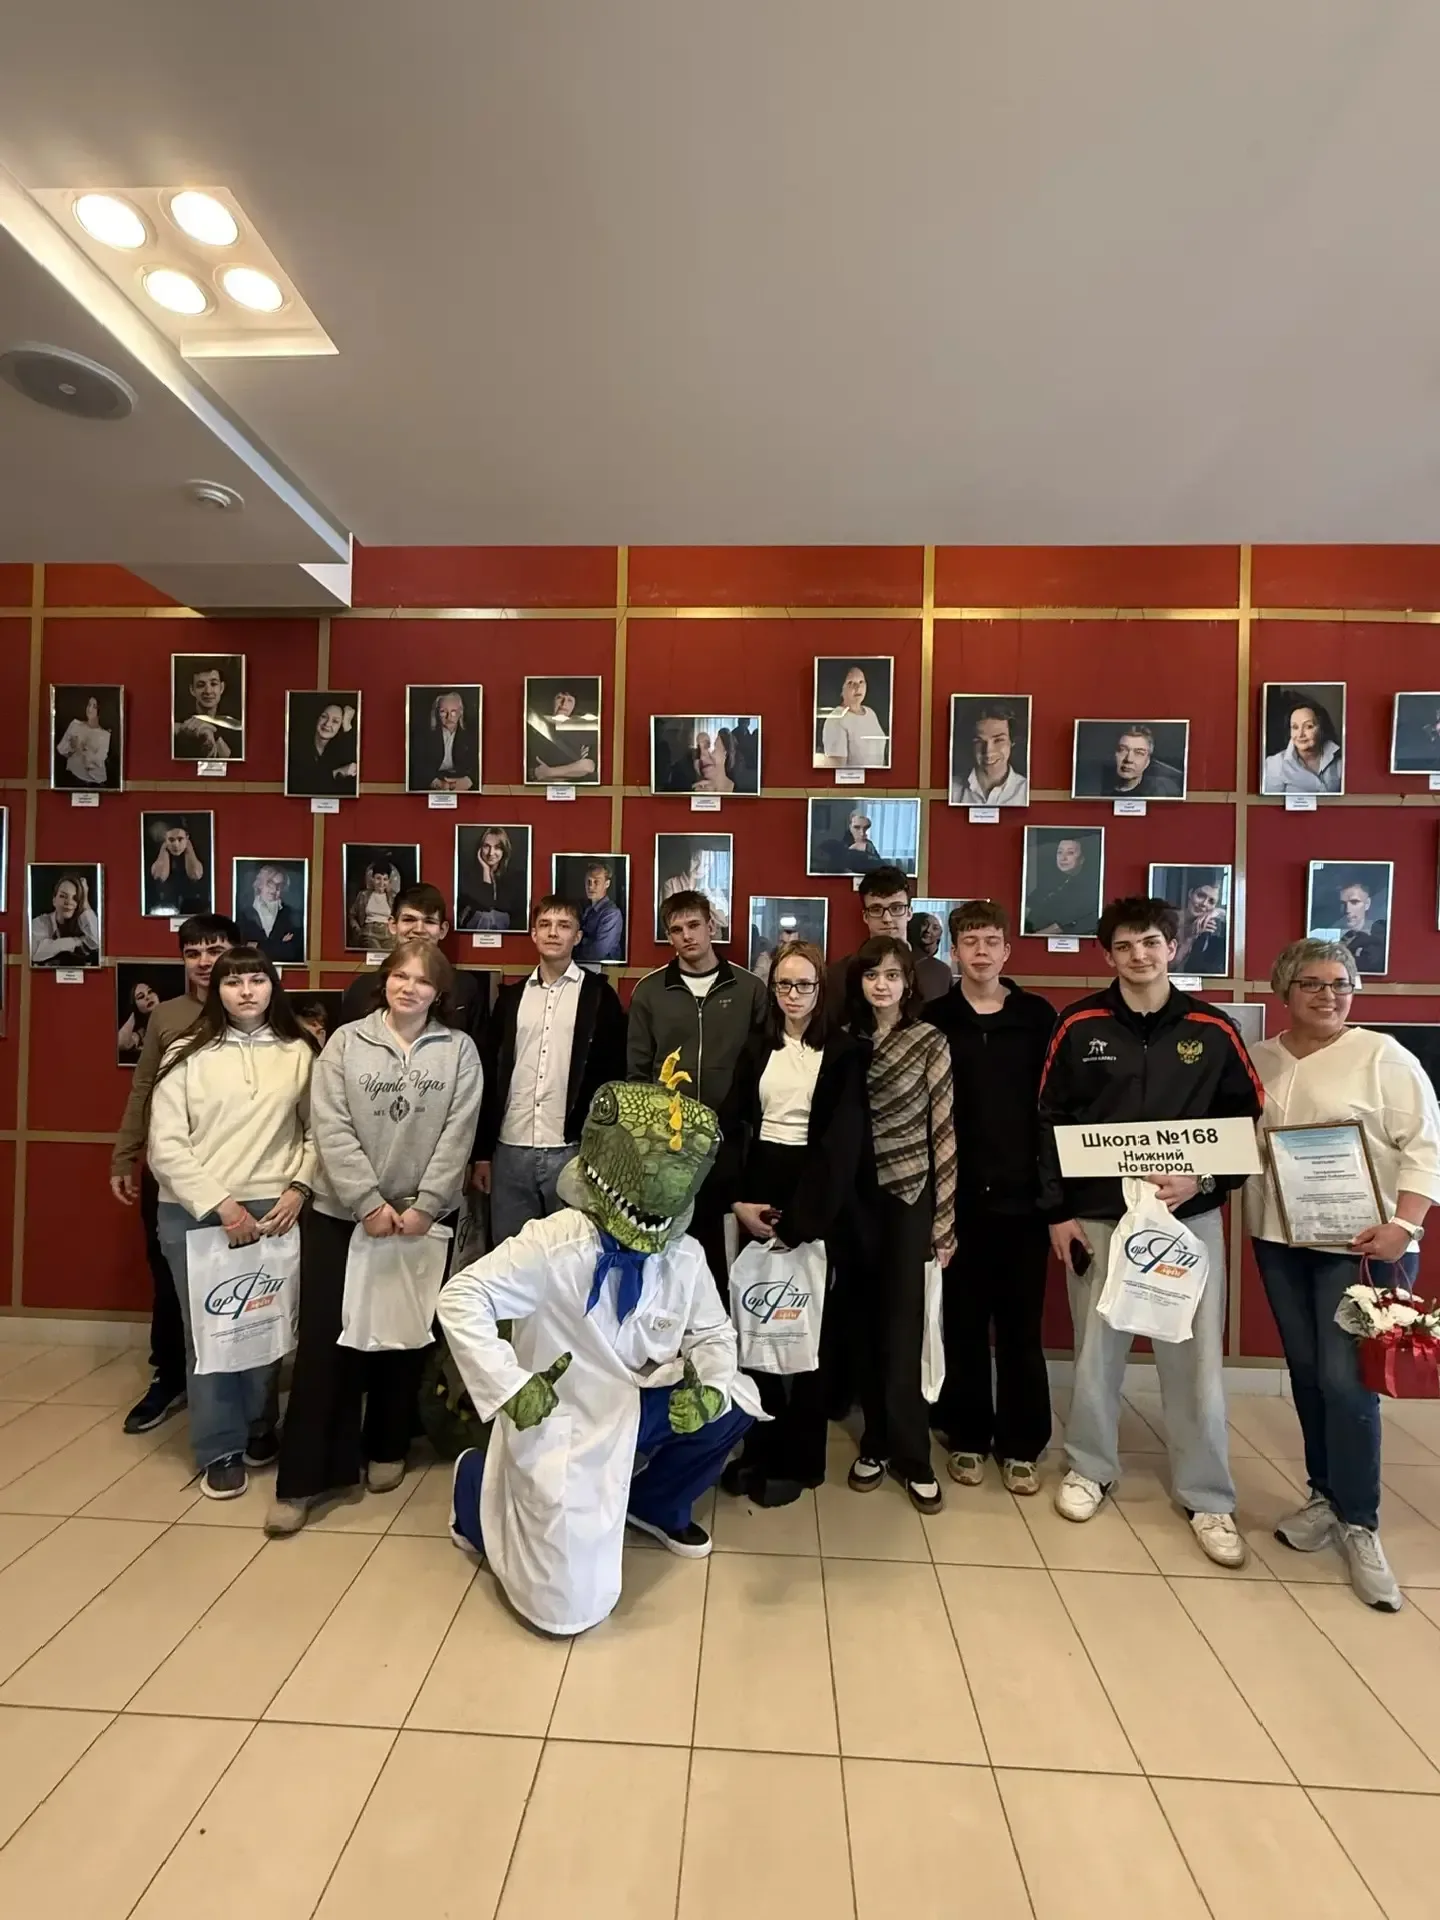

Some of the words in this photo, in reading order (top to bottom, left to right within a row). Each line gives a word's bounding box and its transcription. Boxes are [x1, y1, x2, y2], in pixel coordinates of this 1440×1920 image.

[409, 1068, 446, 1097] Vegas
[1081, 1133, 1150, 1147] Школа
[1156, 1128, 1219, 1145] №168
[1123, 1148, 1184, 1161] Нижний
[1118, 1161, 1194, 1174] Новгород
